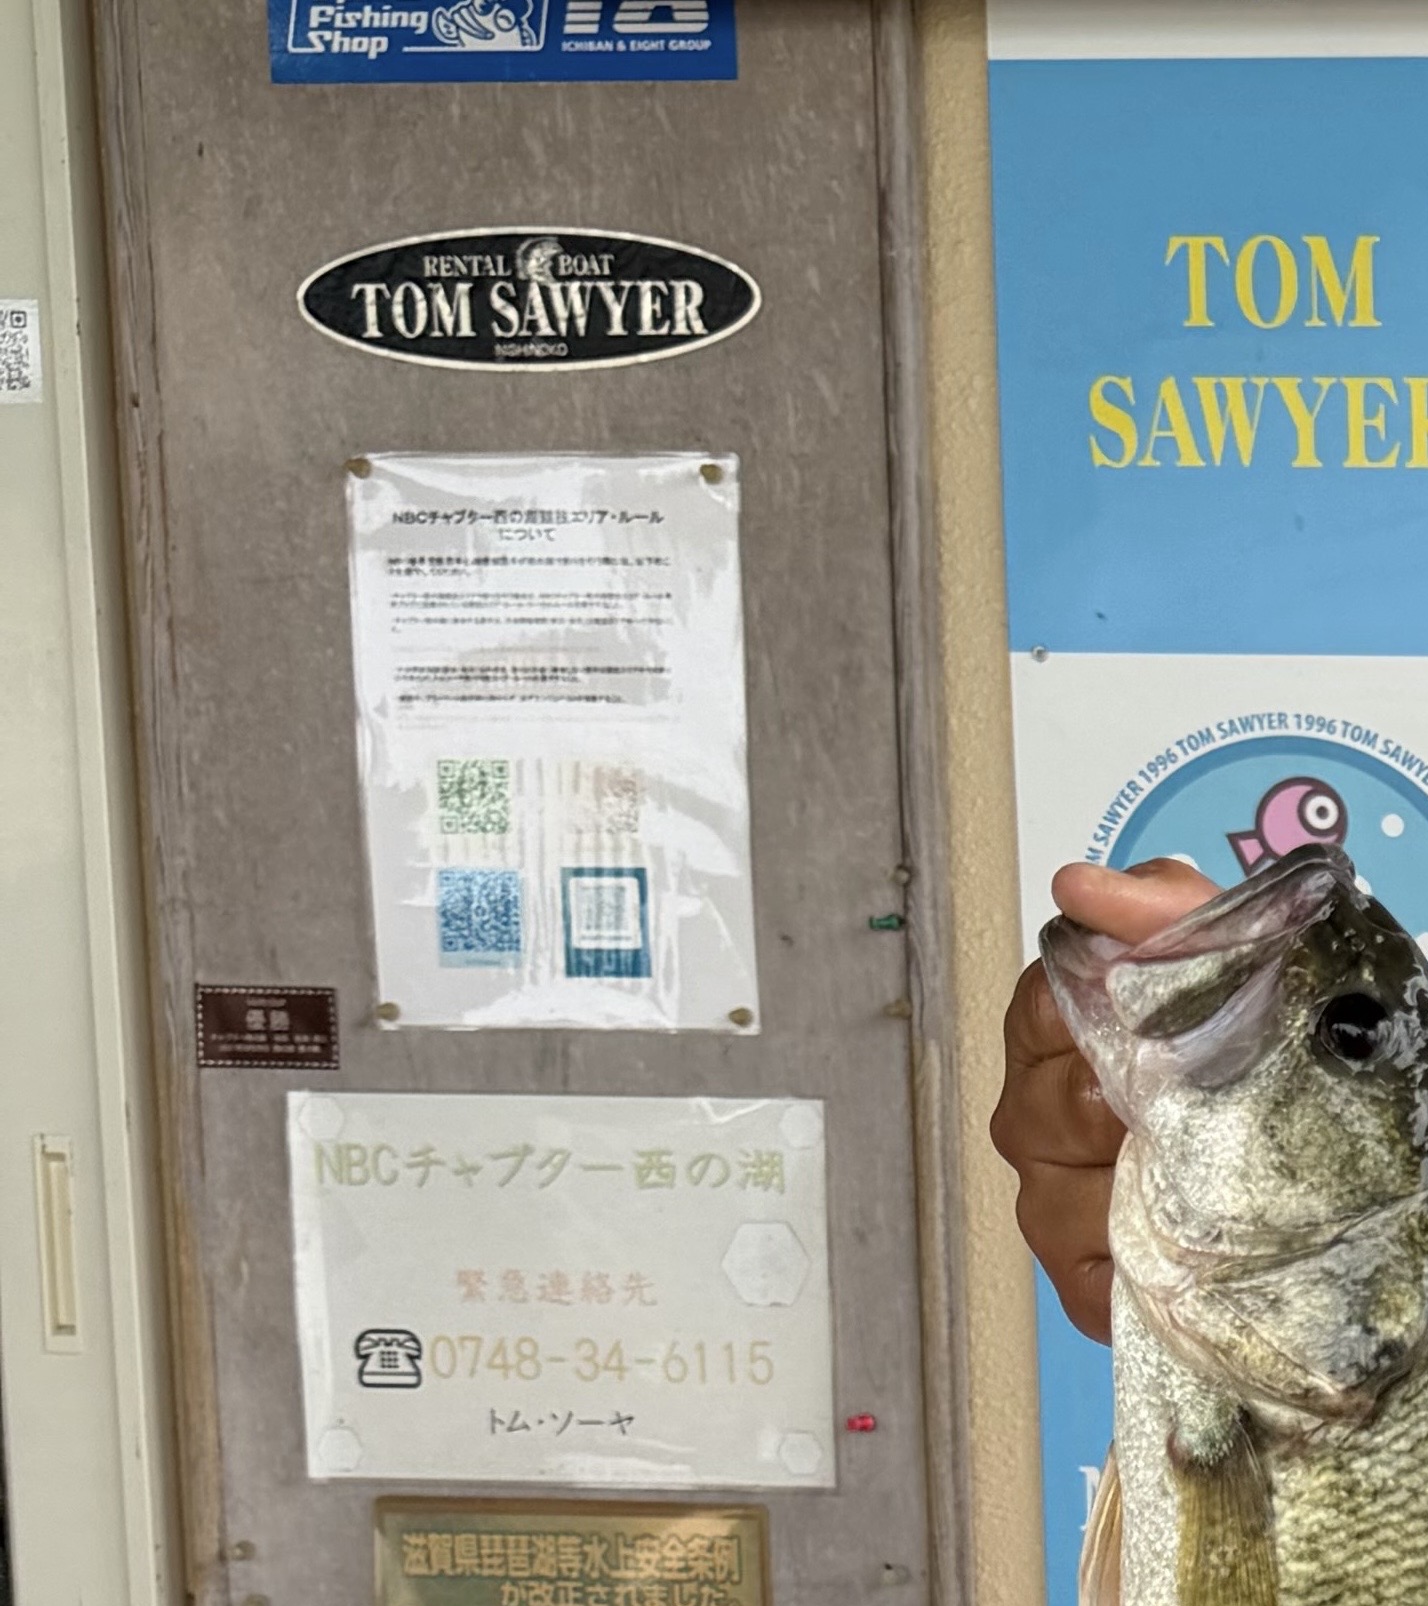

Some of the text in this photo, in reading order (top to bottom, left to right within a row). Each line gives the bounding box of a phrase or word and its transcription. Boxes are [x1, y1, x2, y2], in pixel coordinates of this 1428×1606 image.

[309, 6, 428, 34] Fishing
[307, 31, 388, 59] Shop
[561, 40, 614, 52] ICHIBAN
[629, 40, 665, 51] EIGHT
[668, 39, 712, 51] GROUP
[423, 253, 615, 278] RENTAL BOAT
[1164, 234, 1382, 329] TOM
[350, 279, 709, 339] TOM SAWYER
[1091, 778, 1144, 847] SAWYER
[1136, 746, 1179, 784] 1996
[1173, 725, 1216, 756] TOM
[1214, 711, 1289, 740] SAWYER
[1292, 712, 1337, 736] 1996
[1340, 718, 1379, 750] TOM
[313, 1142, 787, 1193] NBCチャプター西の湖
[454, 1267, 659, 1307] 緊急連絡先
[428, 1335, 776, 1387] 0748-34-6115
